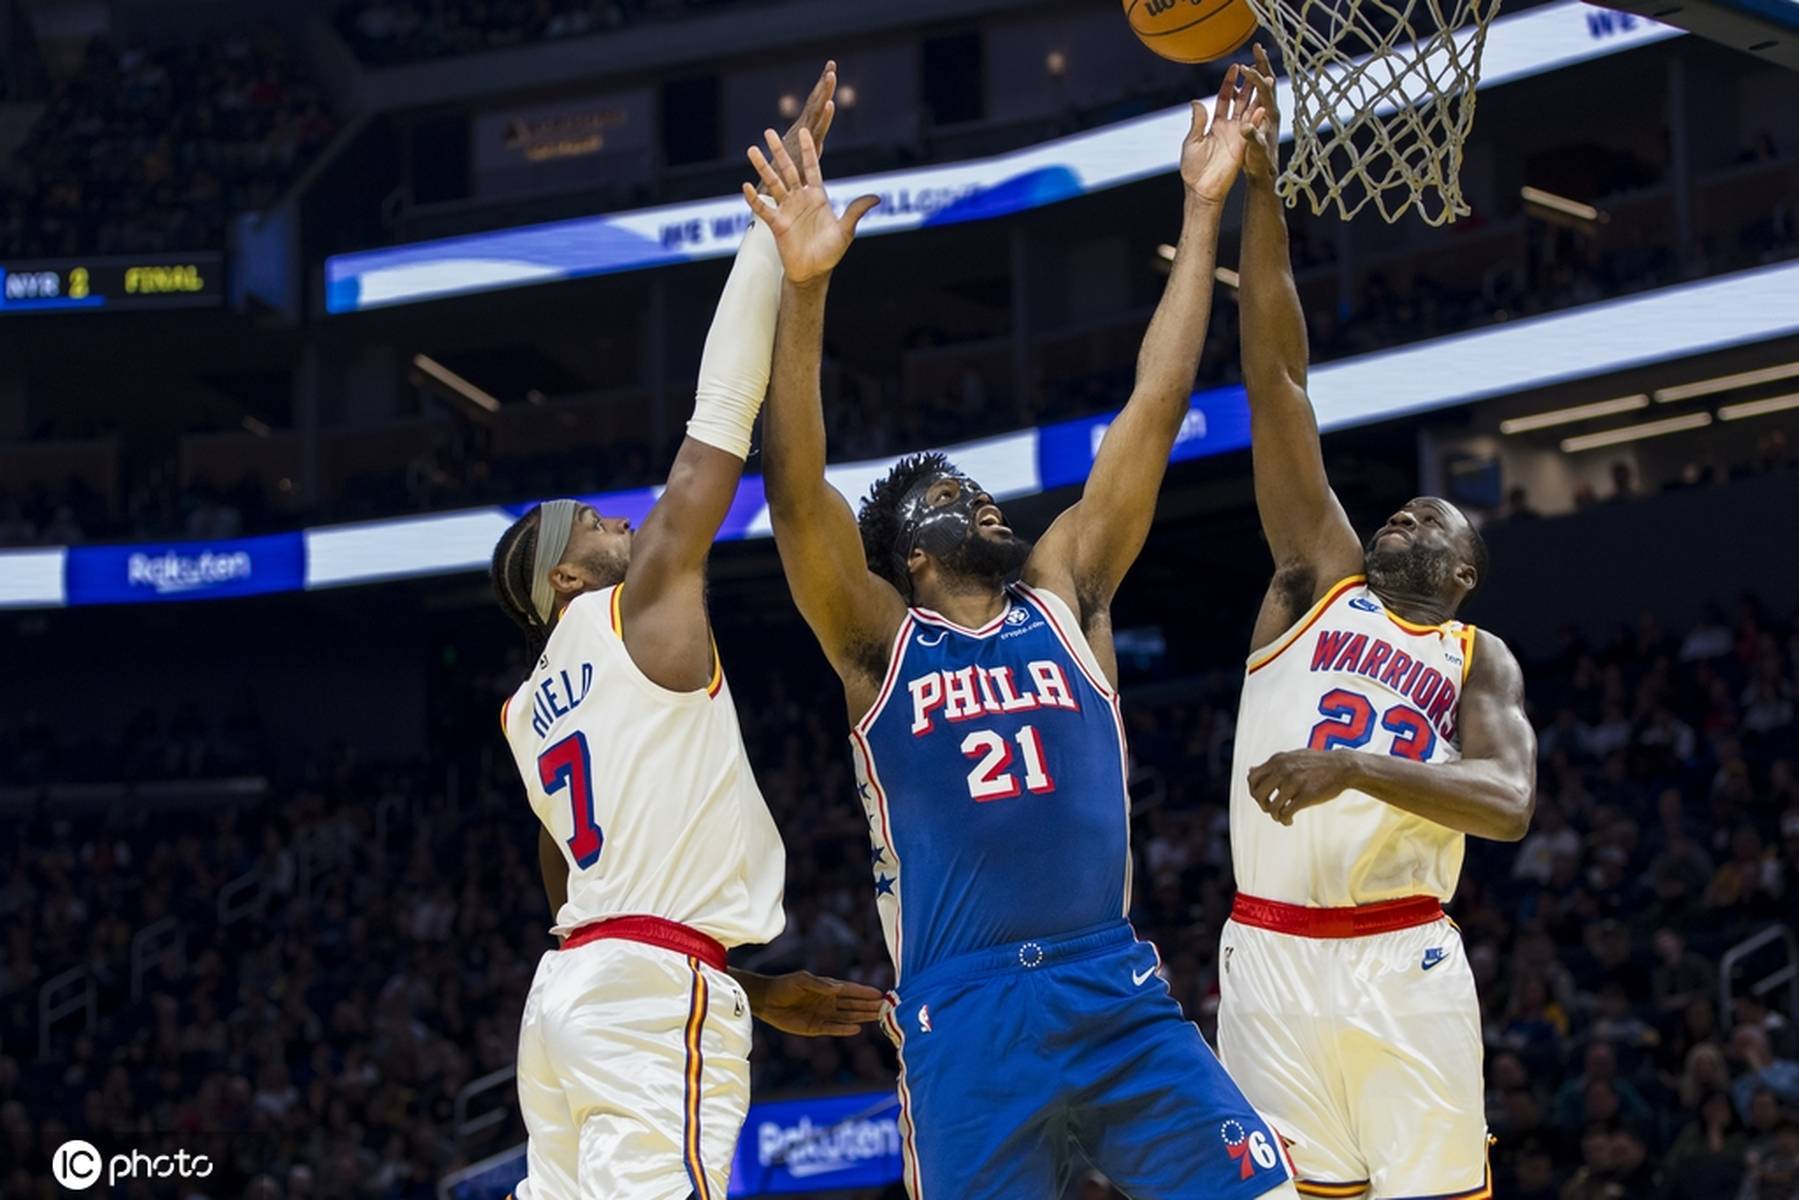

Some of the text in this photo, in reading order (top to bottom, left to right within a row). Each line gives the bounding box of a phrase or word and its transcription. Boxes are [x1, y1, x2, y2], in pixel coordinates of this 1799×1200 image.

[6, 272, 60, 298] NYR
[124, 264, 204, 294] FINAL
[128, 549, 251, 588] Rakuten
[531, 662, 593, 739] HIELD
[908, 660, 1080, 739] PHILA
[1308, 688, 1437, 763] 23
[538, 730, 604, 870] 7
[961, 725, 1056, 803] 21
[758, 1116, 899, 1168] Rakuten
[1225, 1131, 1277, 1181] 76
